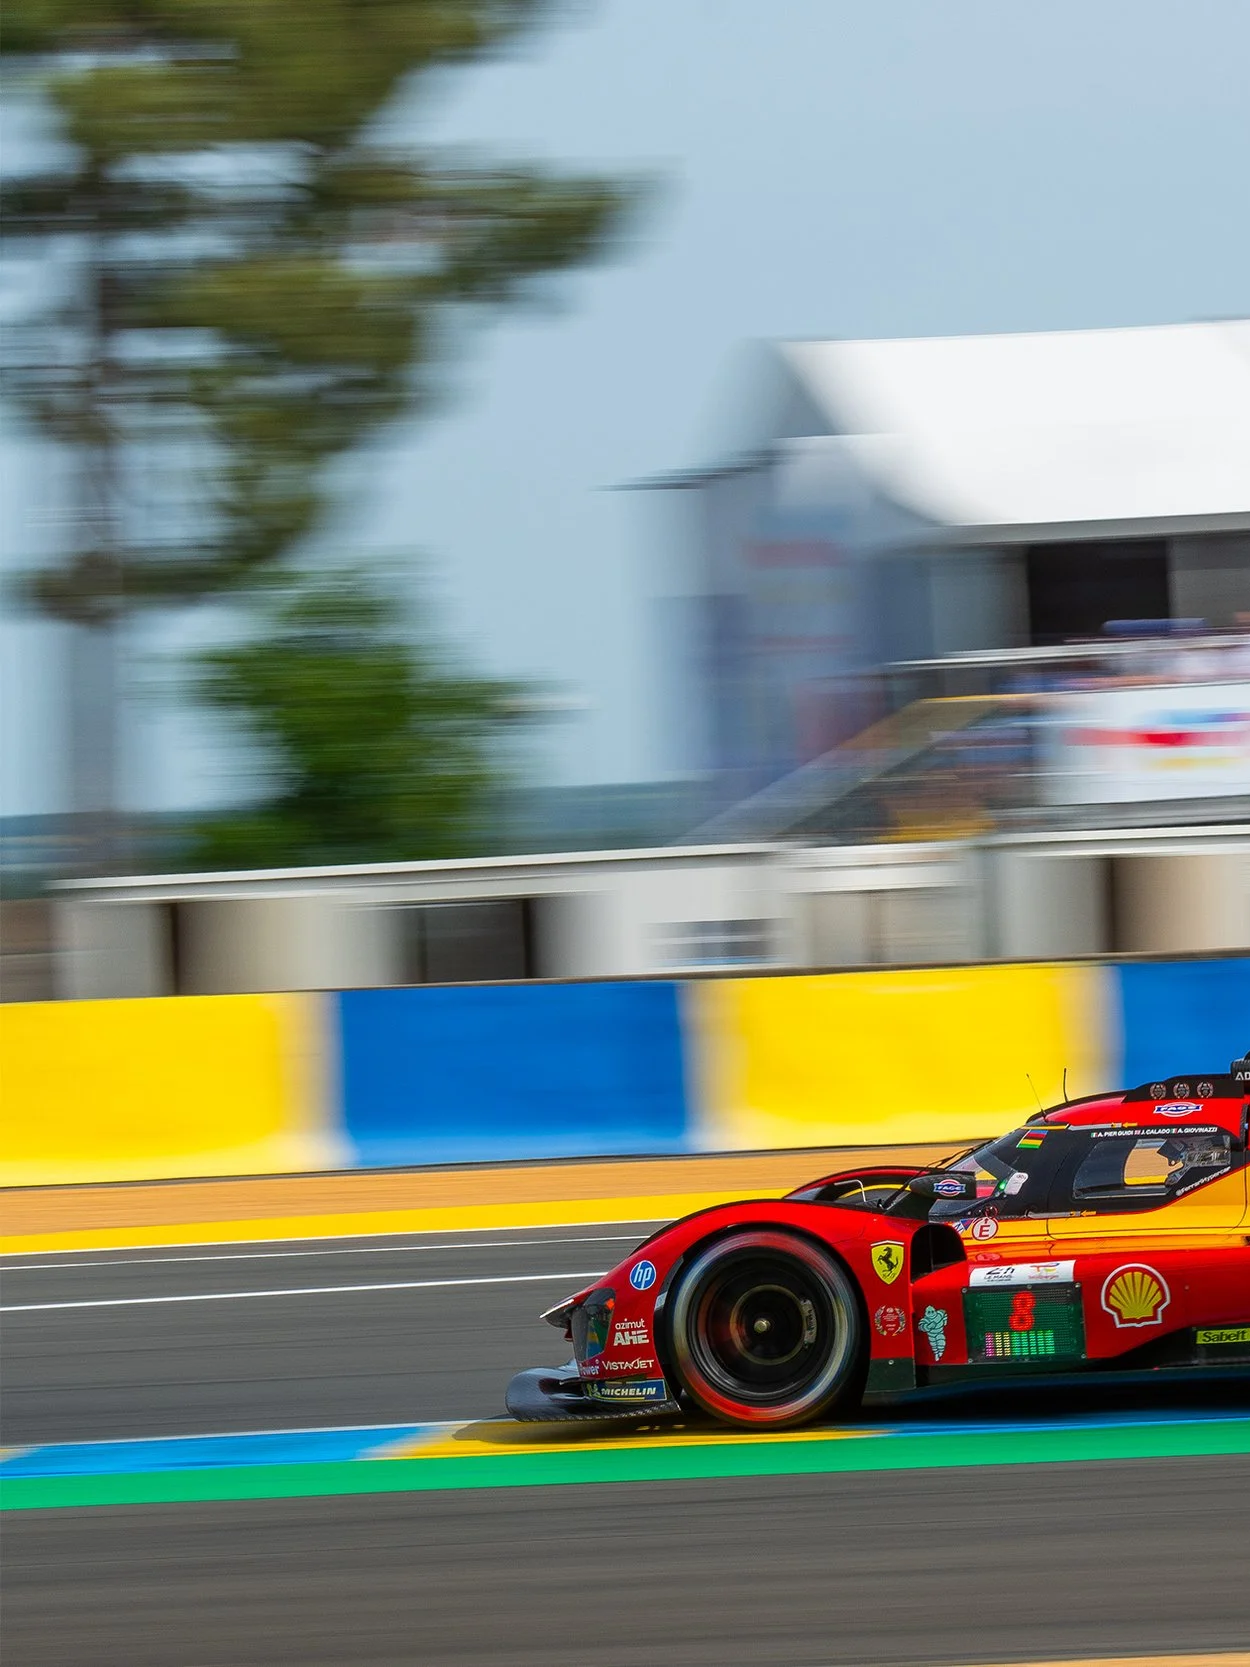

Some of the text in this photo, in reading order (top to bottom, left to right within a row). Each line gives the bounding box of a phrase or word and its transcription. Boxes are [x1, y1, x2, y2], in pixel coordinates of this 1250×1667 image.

[978, 1224, 990, 1238] E
[633, 1260, 652, 1290] hp
[1009, 1290, 1036, 1332] 8
[615, 1318, 645, 1330] azimut
[1202, 1330, 1247, 1343] Sabelt
[600, 1387, 656, 1396] MICHELIN
